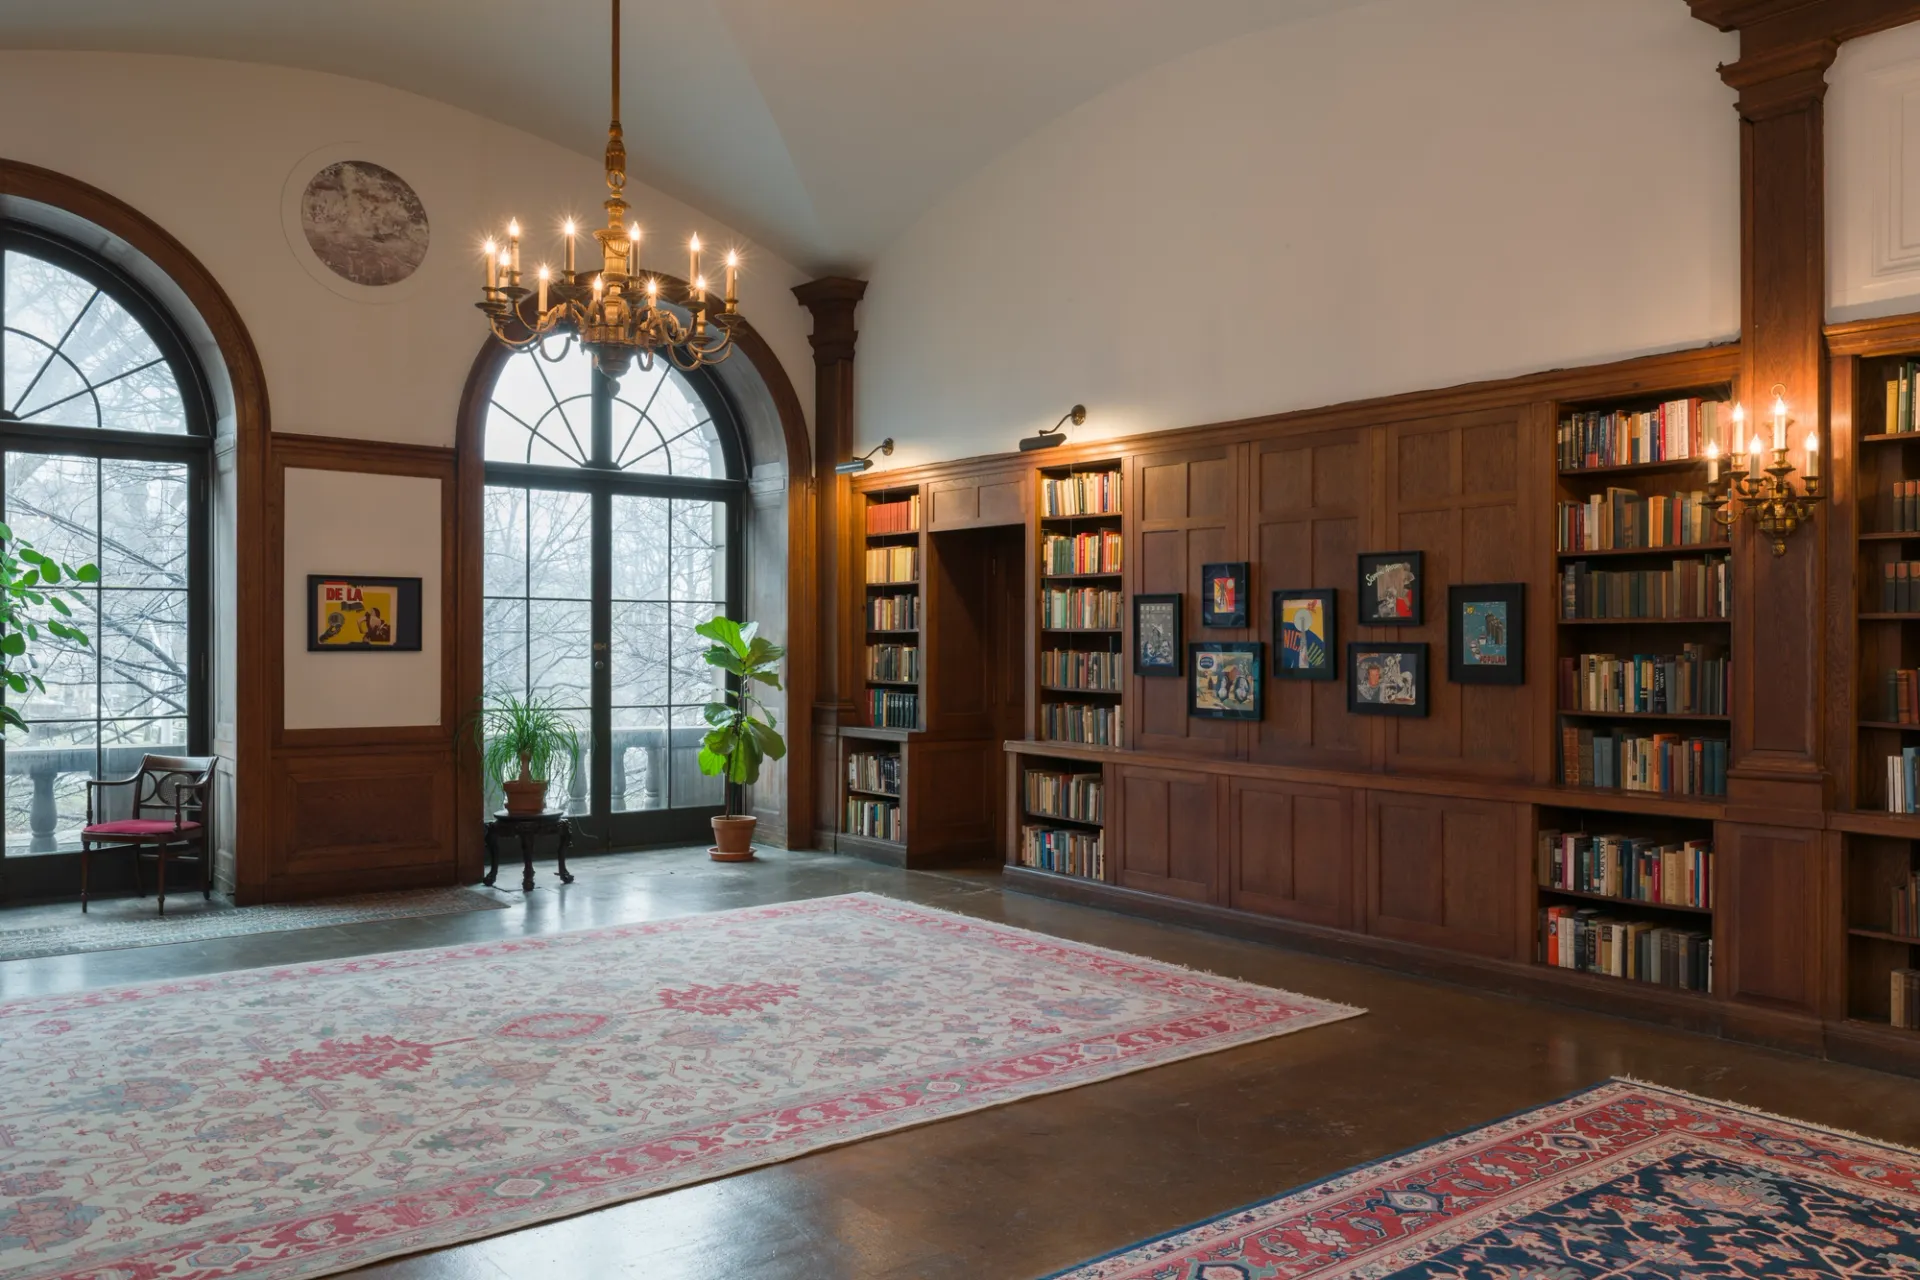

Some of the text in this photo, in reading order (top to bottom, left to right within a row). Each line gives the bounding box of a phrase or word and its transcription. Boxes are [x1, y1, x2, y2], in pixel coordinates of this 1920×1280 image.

[326, 588, 363, 601] DE LA
[1284, 628, 1301, 652] NIC
